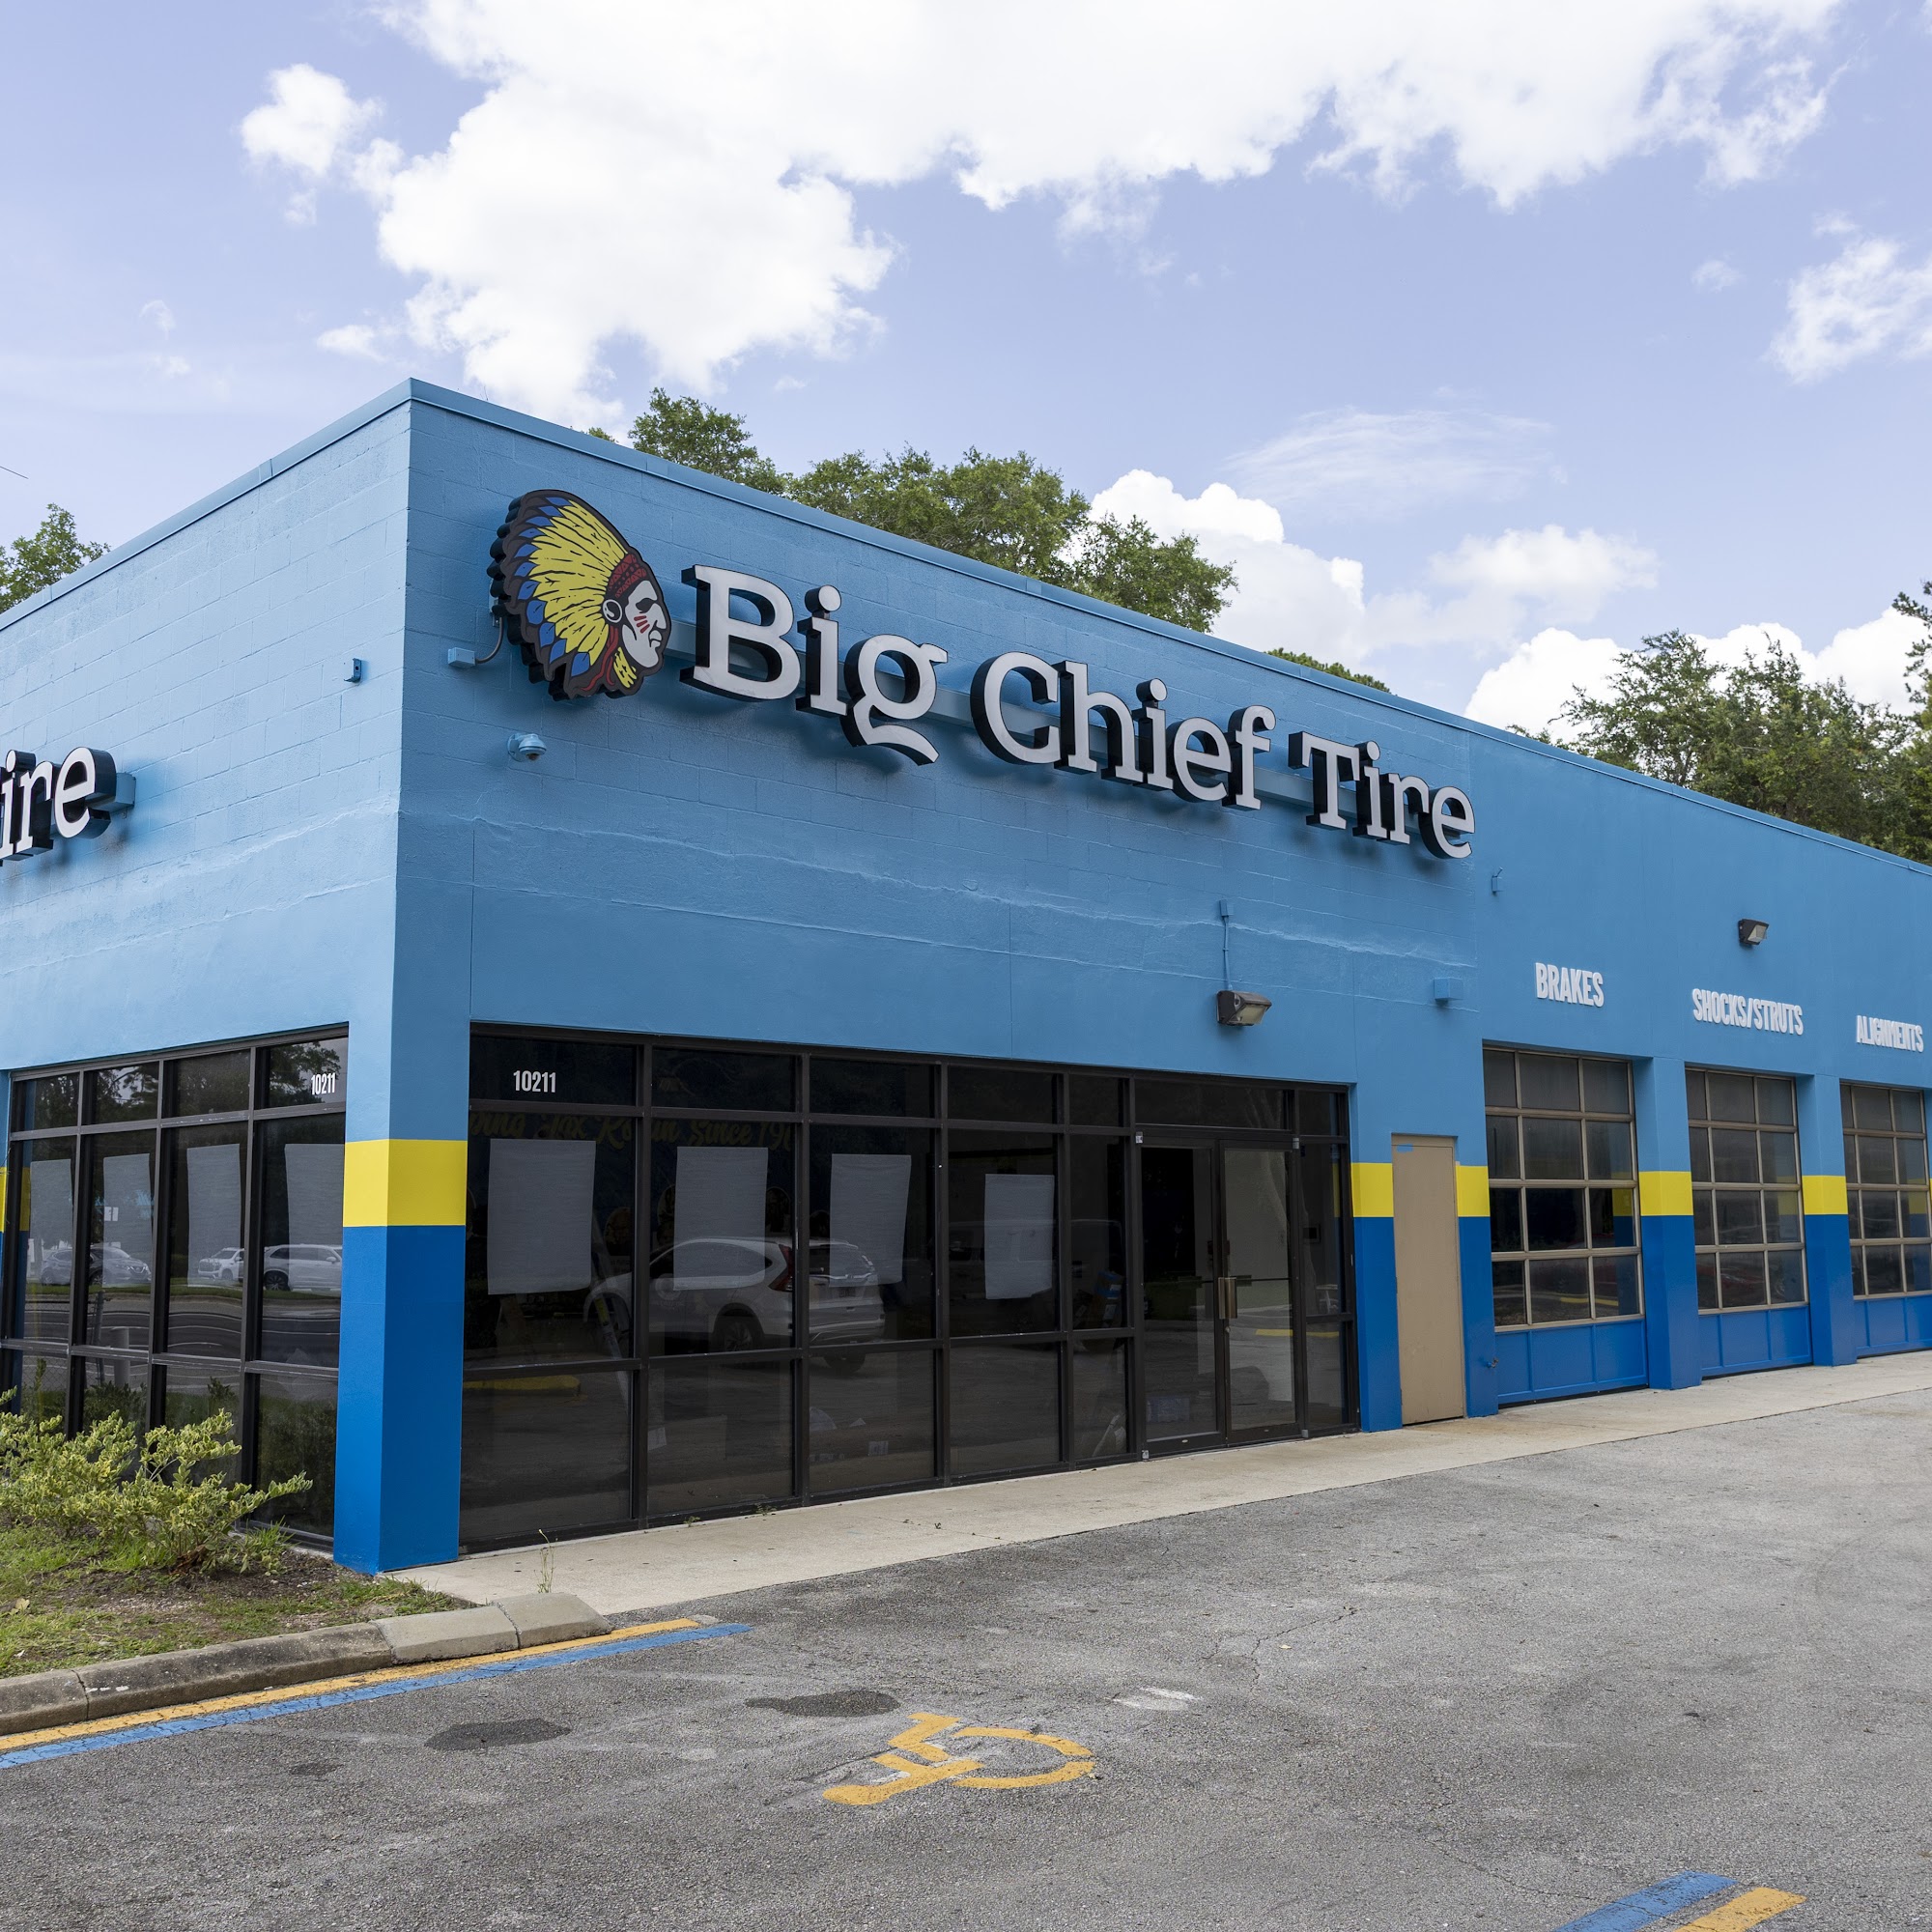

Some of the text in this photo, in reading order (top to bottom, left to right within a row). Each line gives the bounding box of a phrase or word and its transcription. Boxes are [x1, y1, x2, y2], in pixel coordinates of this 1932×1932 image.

[679, 564, 1475, 859] Big Chief Tire
[0, 747, 117, 862] ire
[1535, 962, 1604, 1008] BRAKES
[1691, 988, 1804, 1036] SHOCKS/STRUTS
[1857, 1015, 1923, 1052] ALIGNMENTS
[311, 1072, 335, 1094] 10211
[513, 1070, 556, 1093] 10211
